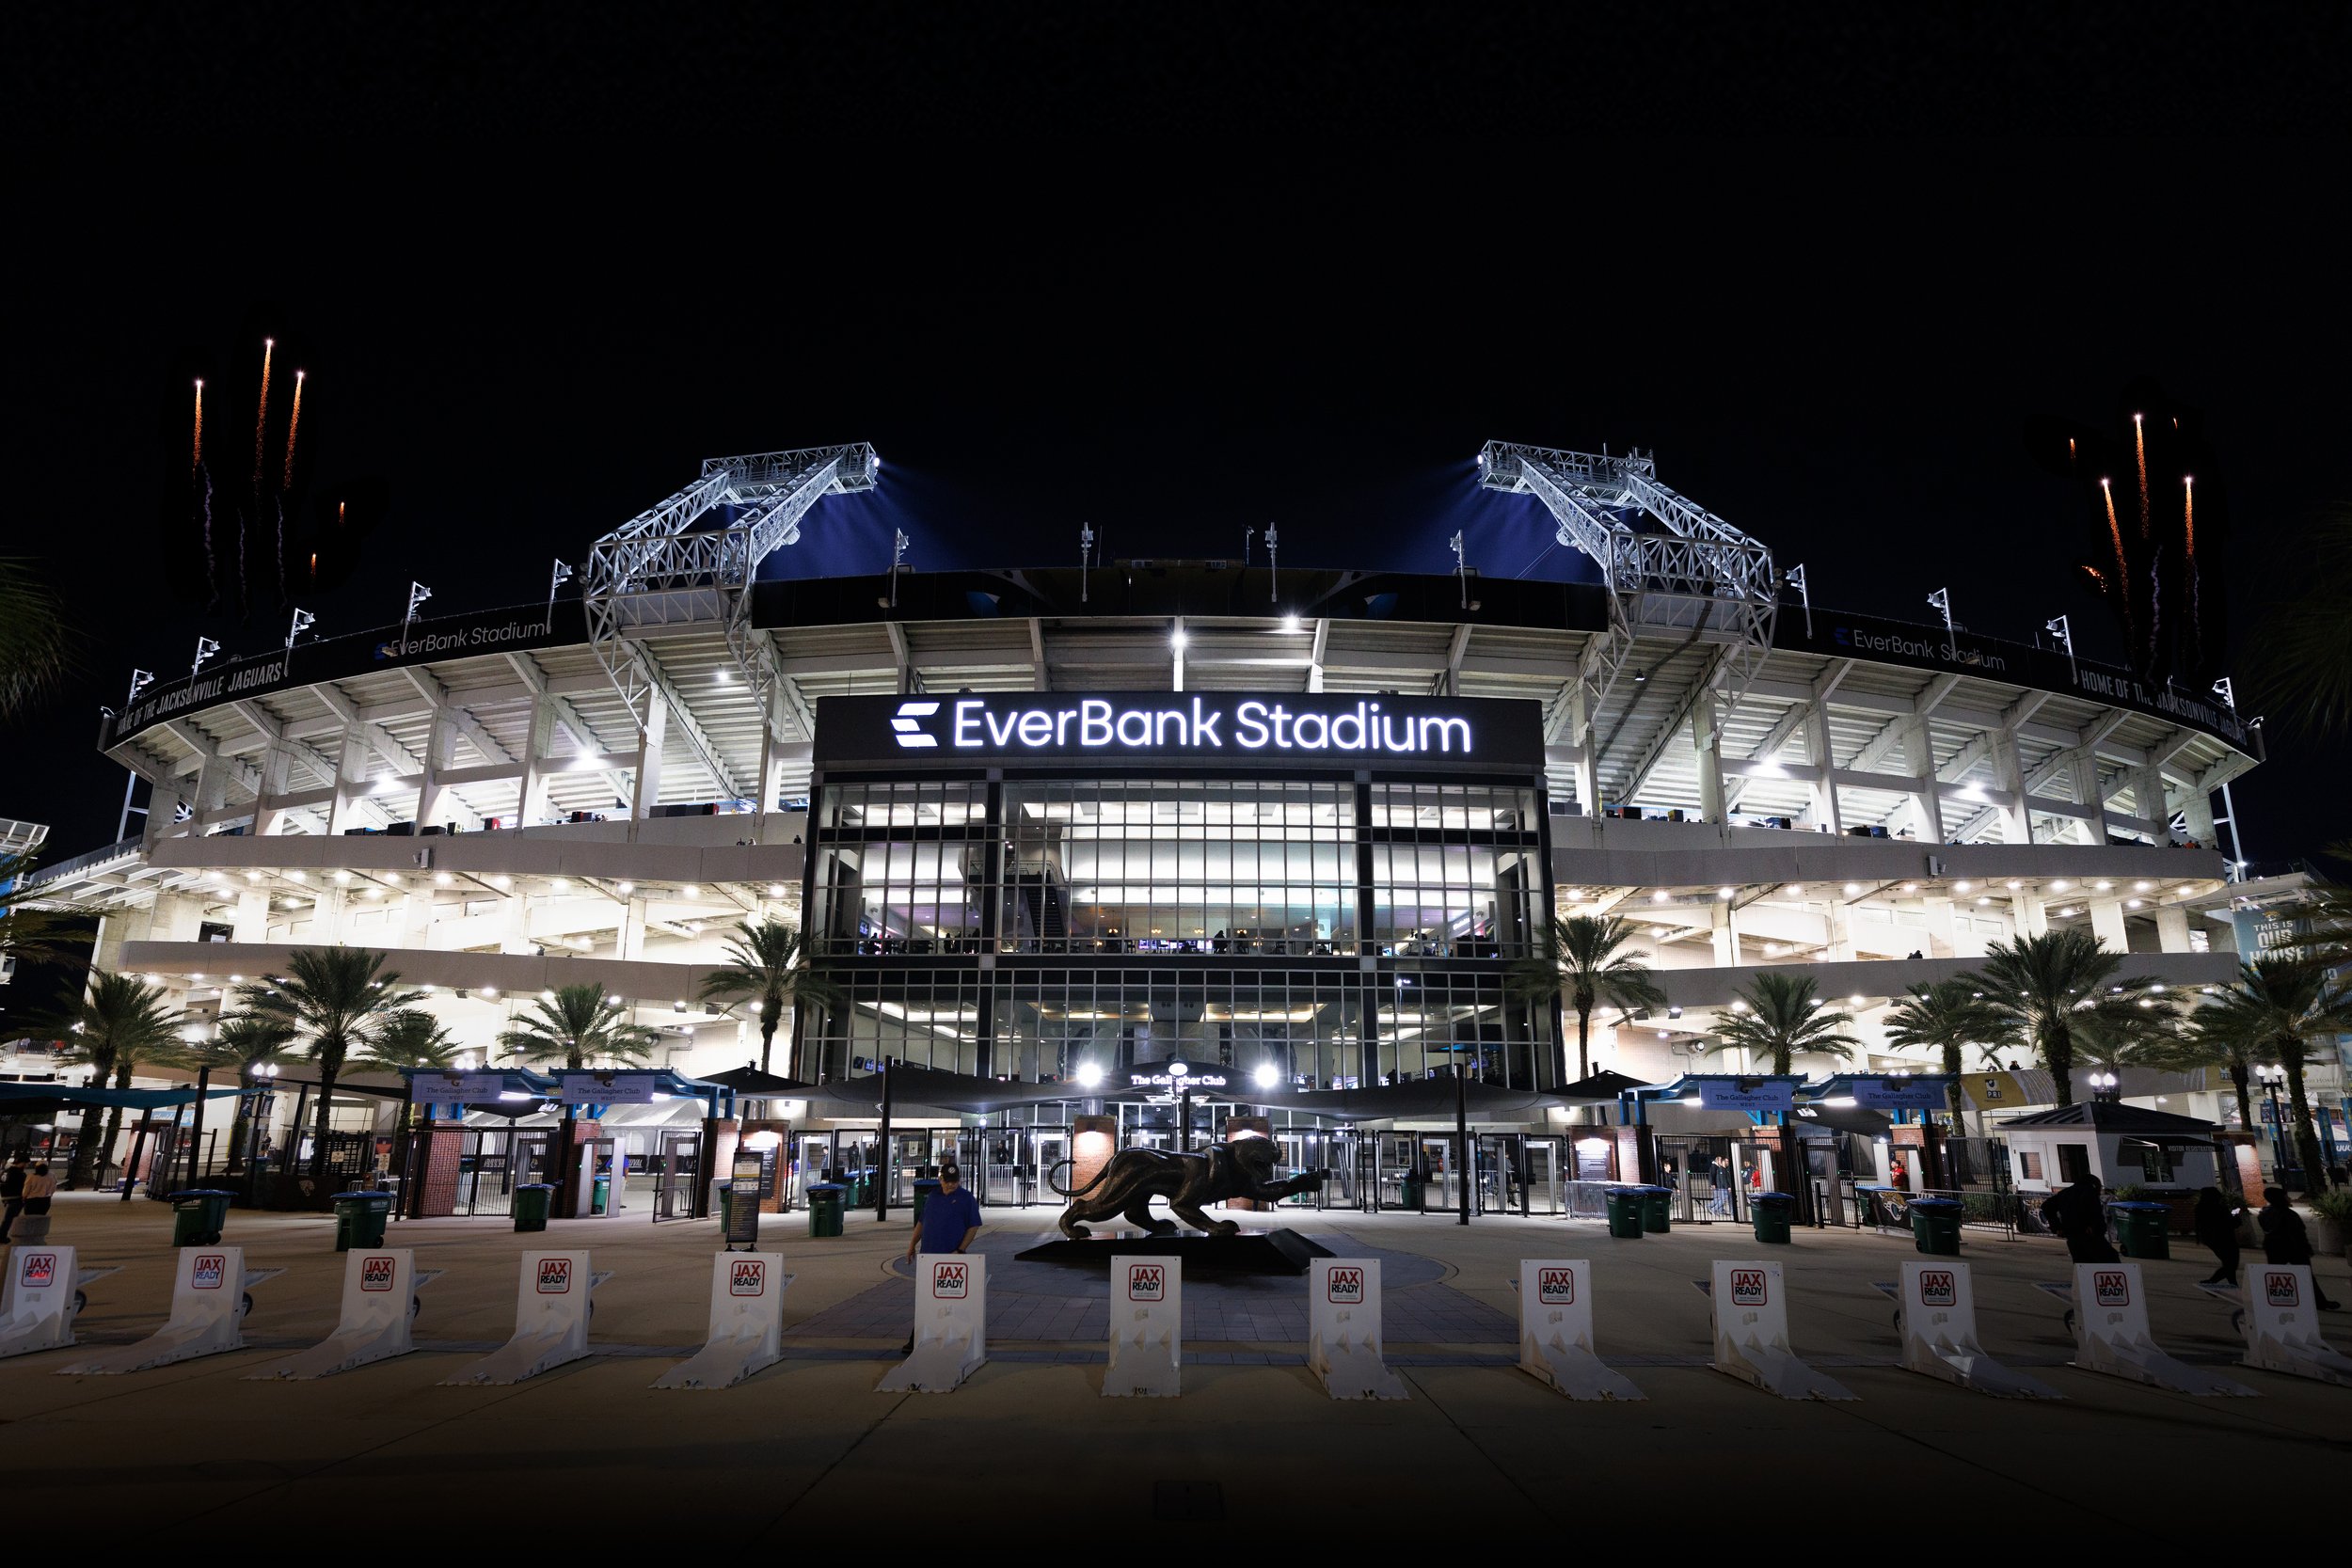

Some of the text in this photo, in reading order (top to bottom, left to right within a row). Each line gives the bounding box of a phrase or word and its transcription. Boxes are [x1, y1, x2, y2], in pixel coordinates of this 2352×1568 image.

[390, 622, 546, 655] EverBank Stadium
[1853, 629, 1934, 658] EverBank
[143, 698, 157, 721] THE
[156, 676, 225, 715] JACKSONVILLE
[228, 661, 282, 692] JAGUARS
[2080, 669, 2113, 697] HOME
[2116, 677, 2130, 700] OF
[2156, 691, 2219, 731] JACKSONVILLE
[954, 697, 1472, 752] EverBank Stadium
[2253, 920, 2294, 932] THIS IS
[1131, 1075, 1227, 1086] The Gallgher Club
[1882, 1092, 1914, 1101] Gallagher
[27, 1258, 52, 1270] JAX
[198, 1259, 221, 1271] JAX
[366, 1260, 390, 1273] JAX
[542, 1262, 567, 1275] JAX
[196, 1271, 220, 1279] READY
[735, 1264, 760, 1277] JAX
[937, 1266, 963, 1279] JAX
[1133, 1269, 1160, 1281] JAX
[734, 1277, 760, 1286] READY
[1332, 1271, 1359, 1284] JAX
[1543, 1272, 1569, 1285] JAX
[1736, 1274, 1761, 1286] JAX
[1925, 1275, 1950, 1287] JAX
[2099, 1275, 2123, 1288] JAX
[2269, 1275, 2293, 1289] JAX
[937, 1280, 963, 1289] READY
[1133, 1282, 1160, 1291] READY
[1331, 1284, 1359, 1293] READY
[1543, 1285, 1569, 1294] READY
[1735, 1287, 1762, 1295] READY
[1925, 1288, 1950, 1296] READY
[2099, 1288, 2123, 1296] READY
[2269, 1289, 2294, 1297] READY
